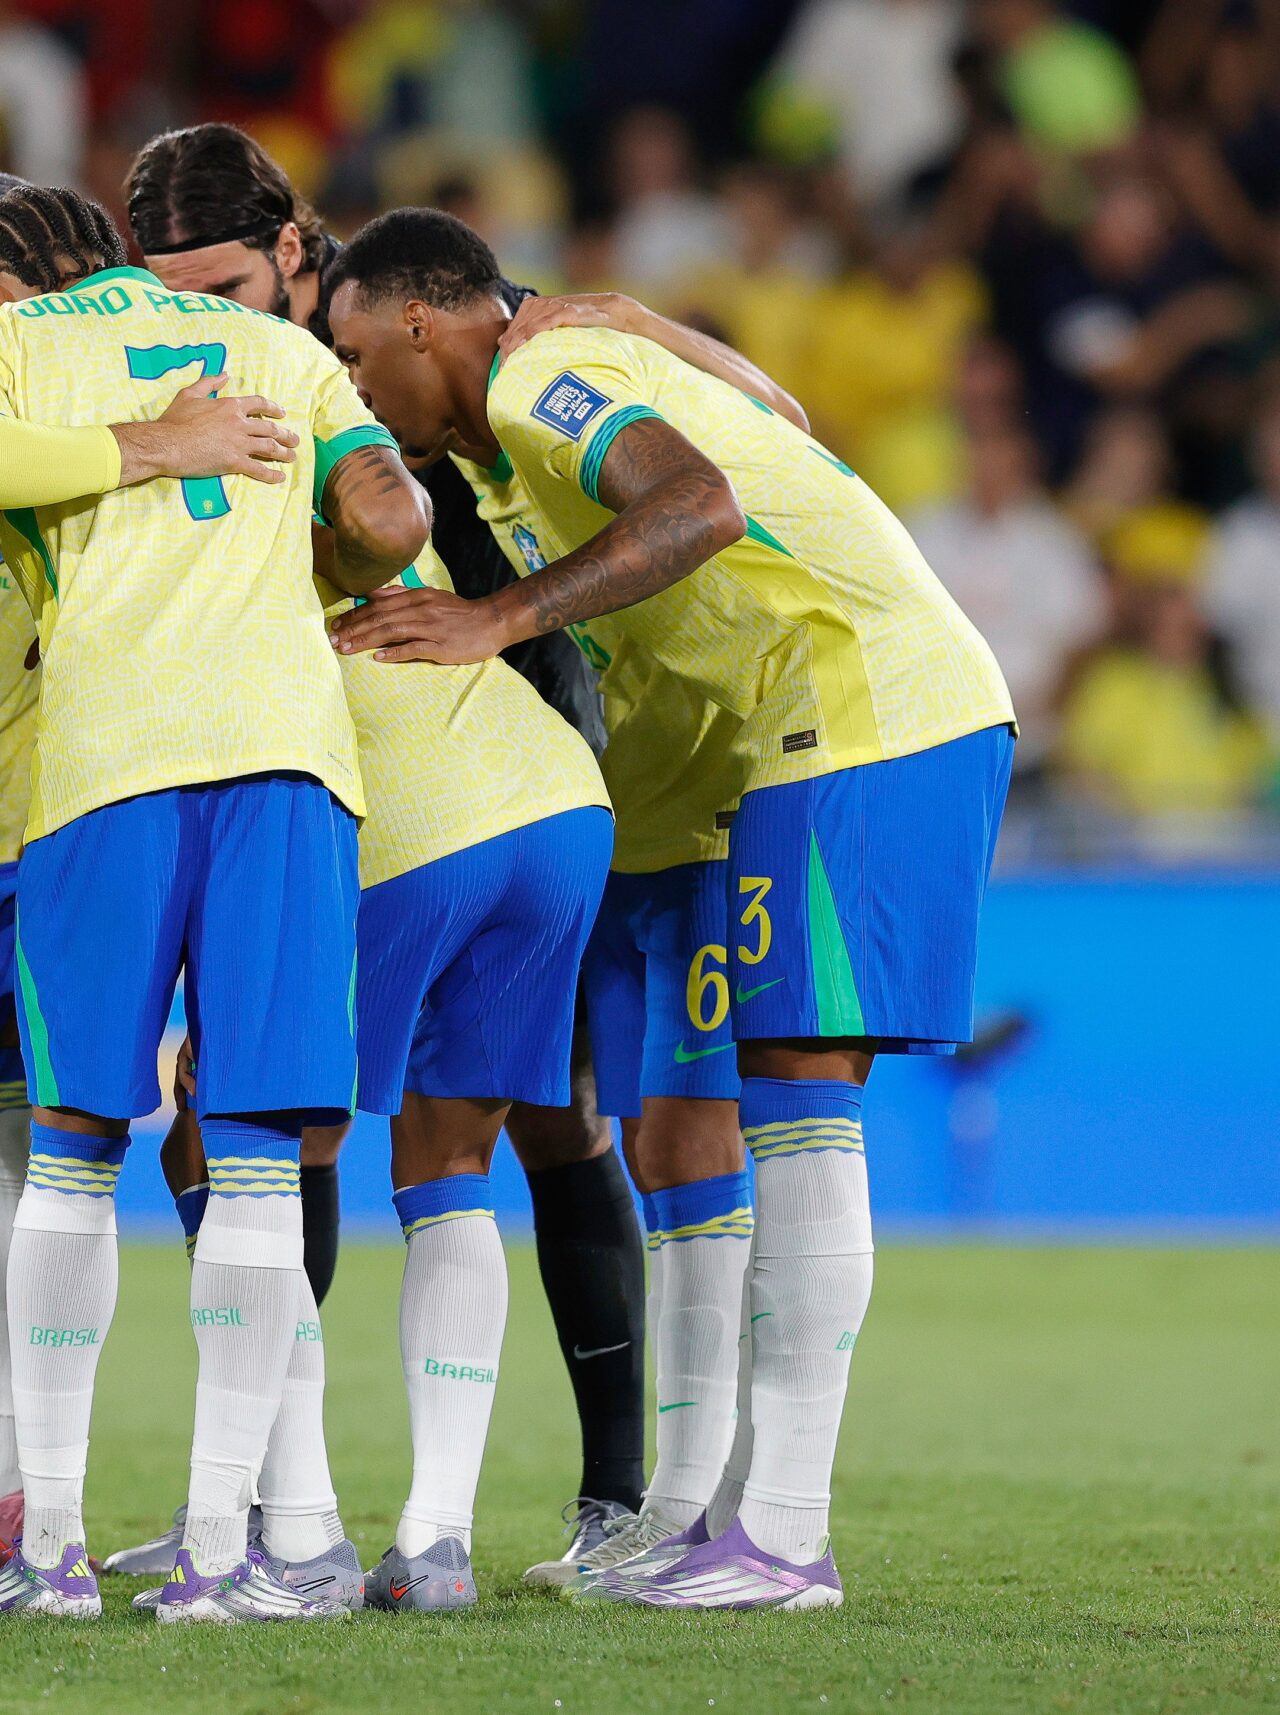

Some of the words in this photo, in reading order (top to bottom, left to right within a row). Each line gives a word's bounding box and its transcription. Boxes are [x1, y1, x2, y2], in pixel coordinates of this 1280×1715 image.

[544, 383, 570, 411] FOOTBALL
[551, 386, 579, 416] UNITES
[124, 342, 232, 521] 7
[737, 876, 773, 965] 3
[686, 943, 730, 1032] 6
[30, 1326, 99, 1348] BRASIL
[424, 1358, 496, 1384] BRASIL
